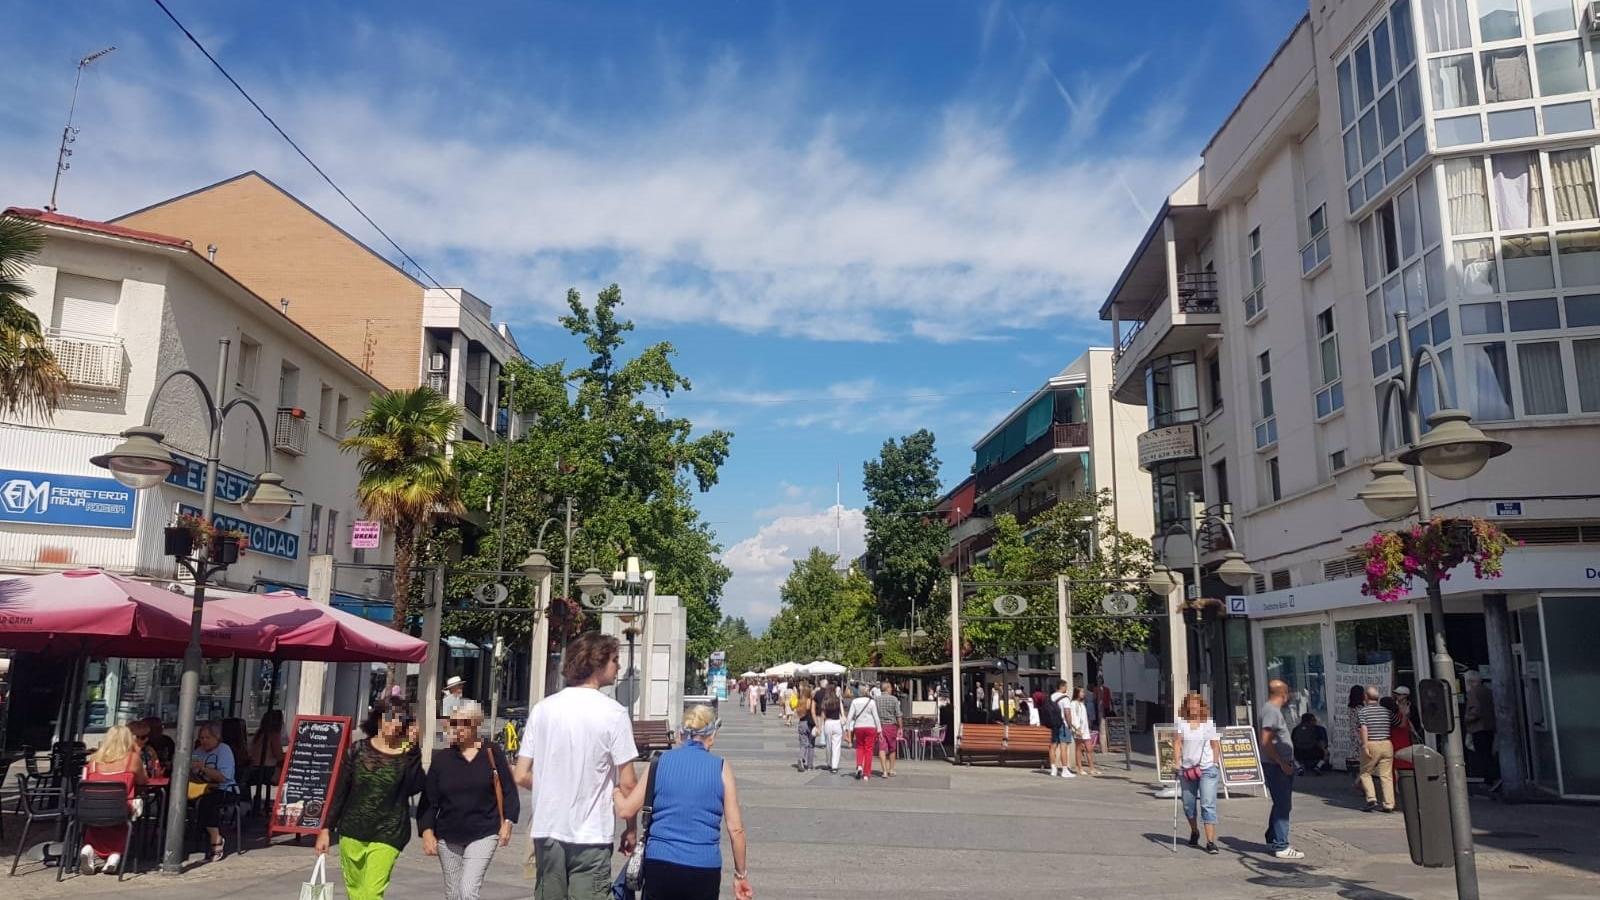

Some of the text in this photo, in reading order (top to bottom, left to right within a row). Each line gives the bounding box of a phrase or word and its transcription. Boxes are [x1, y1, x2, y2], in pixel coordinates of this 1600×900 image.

[52, 487, 128, 501] FERRETERIA
[50, 496, 86, 507] MAJA
[1221, 743, 1252, 752] DE ORO
